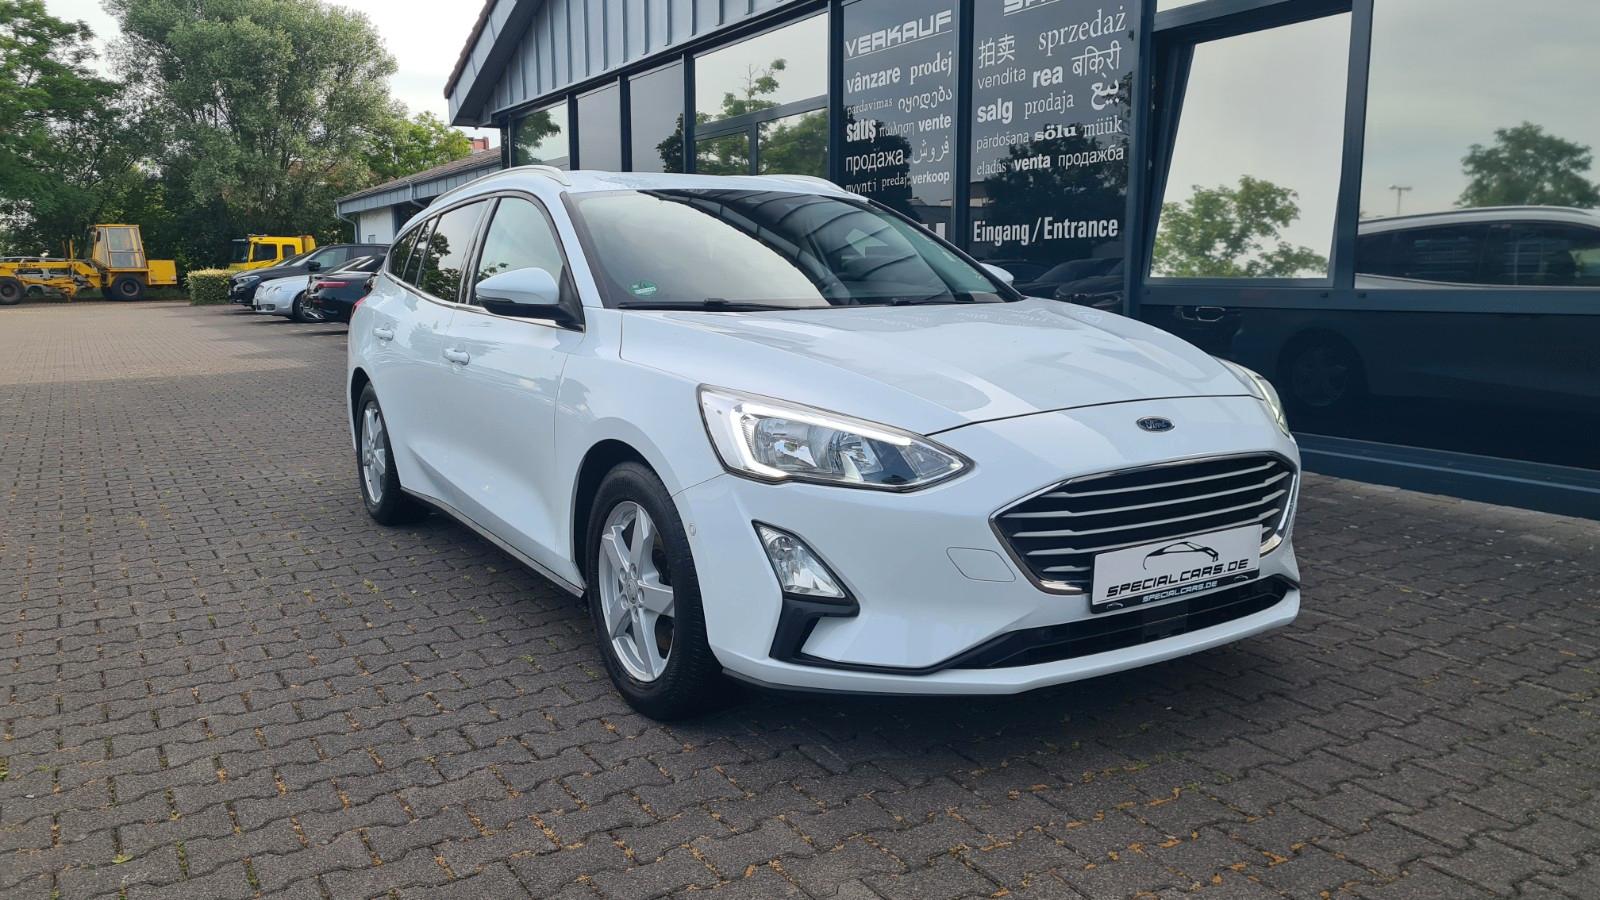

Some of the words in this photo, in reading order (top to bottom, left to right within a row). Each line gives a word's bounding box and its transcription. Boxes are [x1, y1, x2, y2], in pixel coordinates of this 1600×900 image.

[845, 9, 952, 57] VERKAUF
[1038, 5, 1127, 57] sprzedaż
[978, 33, 1016, 69] 拍卖
[846, 66, 901, 94] vânzare
[910, 50, 952, 86] prodej
[977, 67, 1026, 90] vendita
[1032, 65, 1064, 89] rea
[846, 97, 893, 119] pardavimas
[976, 98, 1013, 124] salg
[1024, 90, 1075, 120] prodaja
[918, 113, 952, 132] vente
[1033, 124, 1077, 142] sölu
[1083, 115, 1123, 137] müük
[846, 149, 904, 176] продажа
[1013, 153, 1051, 172] venta
[1058, 144, 1124, 169] продажба
[881, 171, 907, 191] predaj
[912, 171, 950, 185] verkoop
[973, 220, 1030, 247] Eingang
[1043, 216, 1119, 240] Entrance
[1106, 558, 1249, 598] SPECIALCARS.DE
